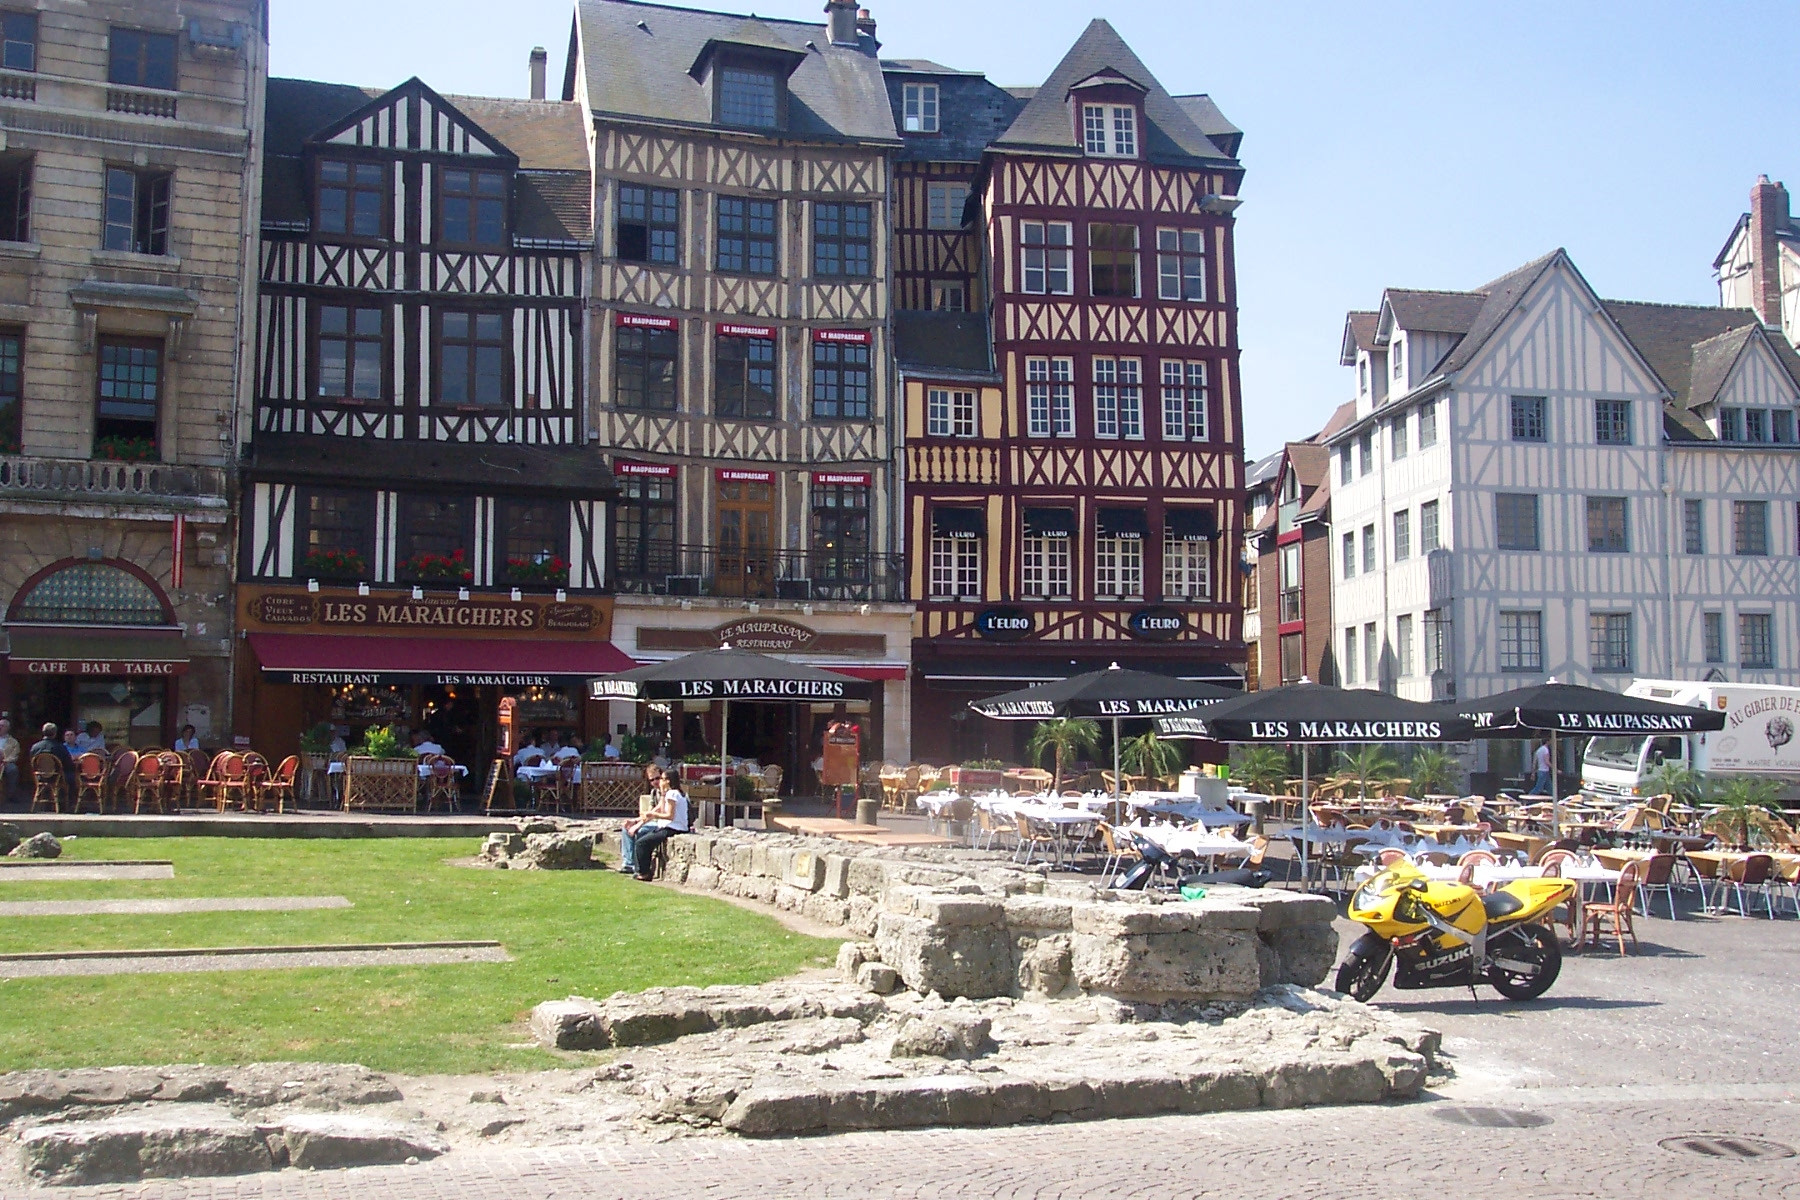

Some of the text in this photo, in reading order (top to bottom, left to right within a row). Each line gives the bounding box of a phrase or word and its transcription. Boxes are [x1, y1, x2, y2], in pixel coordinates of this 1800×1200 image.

[623, 316, 671, 326] LE MAUPASSANT
[723, 325, 769, 335] LE MAUPASSANT
[828, 333, 865, 341] MAUPASSANT
[631, 466, 669, 474] MAUPASSANT
[731, 472, 769, 480] MAUPASSANT
[266, 596, 295, 605] CIDRE
[266, 605, 293, 614] VIEUX
[324, 603, 534, 627] LES MARAICHERS
[265, 613, 311, 622] CALVADOS
[987, 616, 1028, 629] L'EURO
[1141, 616, 1180, 629] L'EURO
[720, 622, 812, 642] LE MAUPASSANT
[736, 639, 794, 649] RESTAURANT
[28, 662, 173, 674] CAFE BAR TABAC
[292, 673, 380, 684] RESTAURANT
[437, 675, 460, 684] LES
[680, 680, 843, 696] LES MARAICHERS
[998, 701, 1055, 715] MARAICHERS
[1099, 699, 1224, 714] LES MARAIC
[1729, 709, 1744, 729] AU
[1744, 696, 1777, 719] GIBIER
[1780, 696, 1792, 711] DE
[1557, 713, 1693, 729] LE MAUPASSANT
[1250, 721, 1441, 738] LES MARAICHERS
[1433, 897, 1461, 909] SUZUKI
[1414, 946, 1474, 971] SUZUKI
